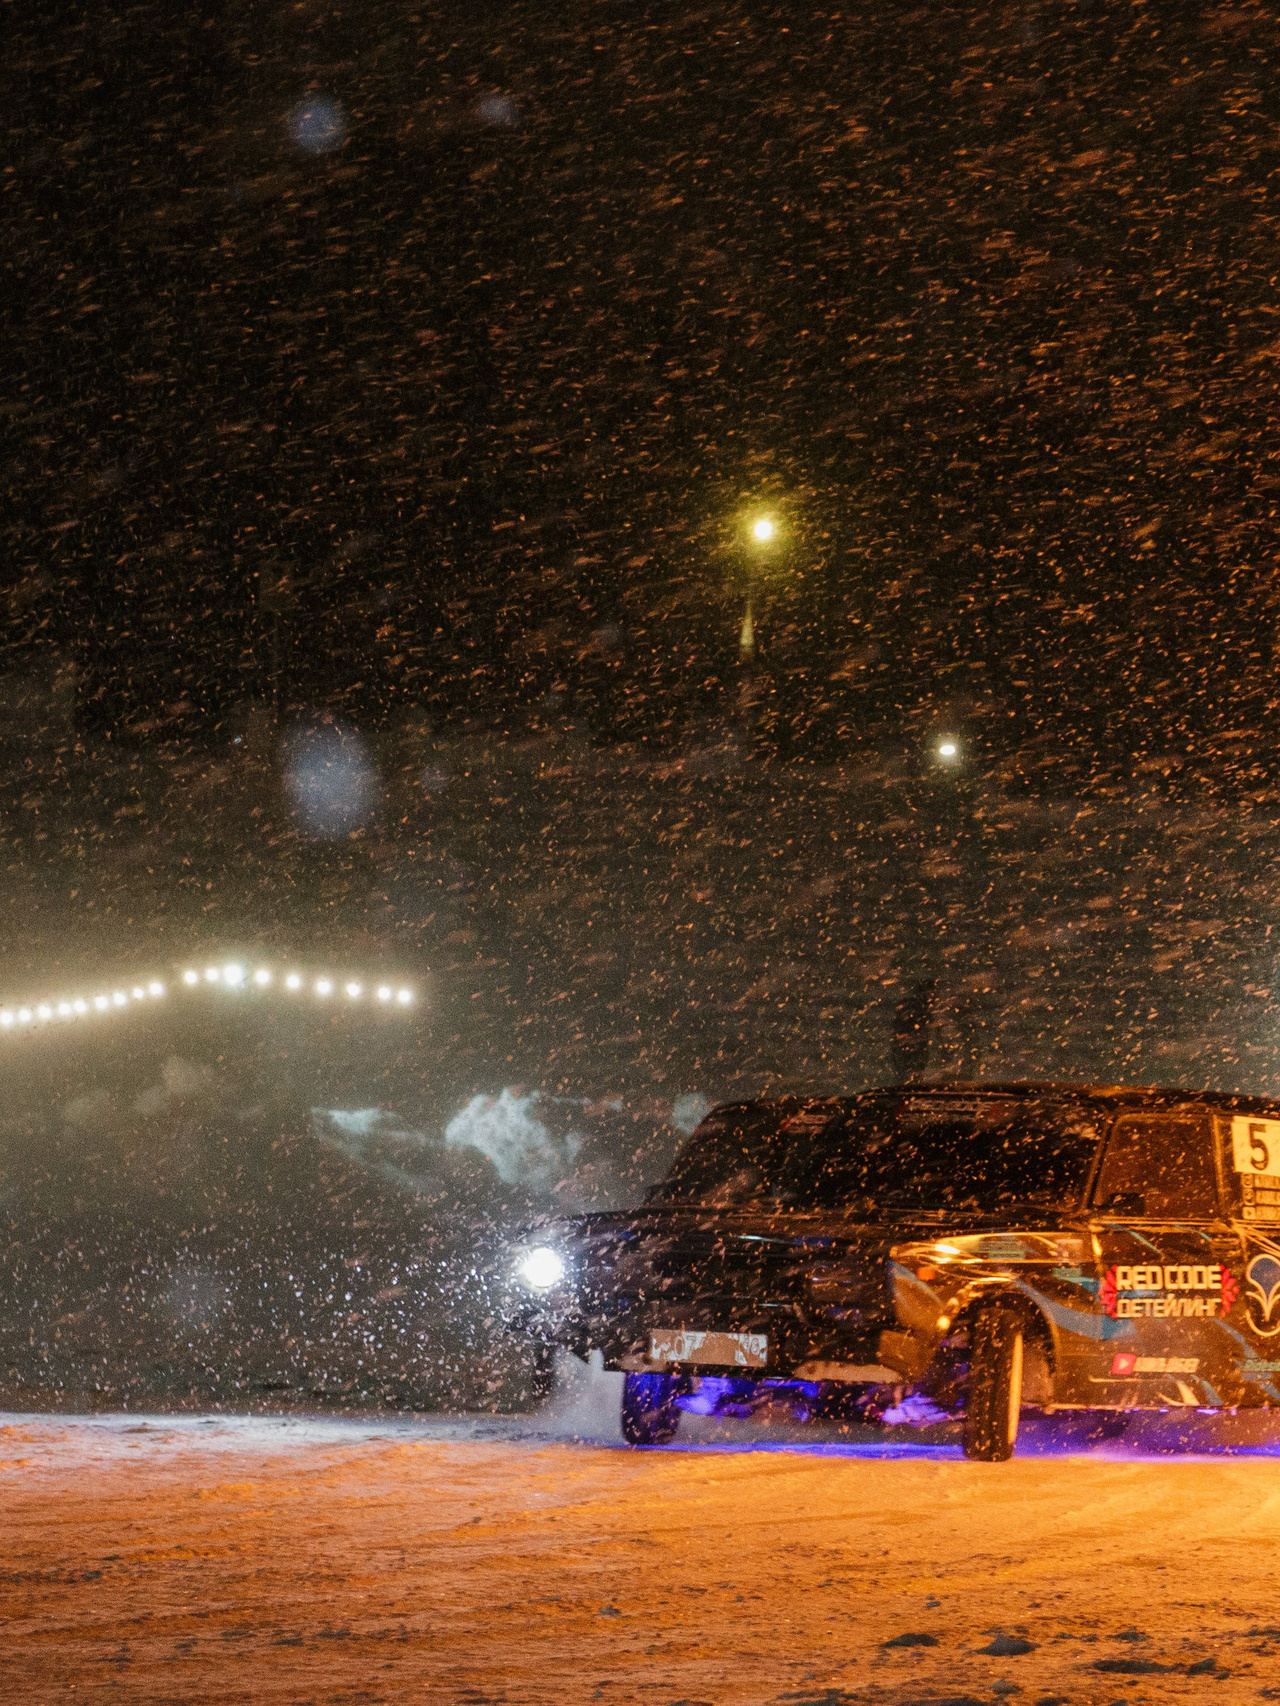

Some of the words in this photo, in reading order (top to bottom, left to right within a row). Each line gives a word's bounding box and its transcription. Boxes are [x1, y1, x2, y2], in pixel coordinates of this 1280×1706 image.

[1248, 1122, 1270, 1171] 5
[1116, 1265, 1163, 1290] RED
[1164, 1265, 1222, 1290] CODE
[1117, 1293, 1222, 1318] ДЕТЕЙЛИНГ
